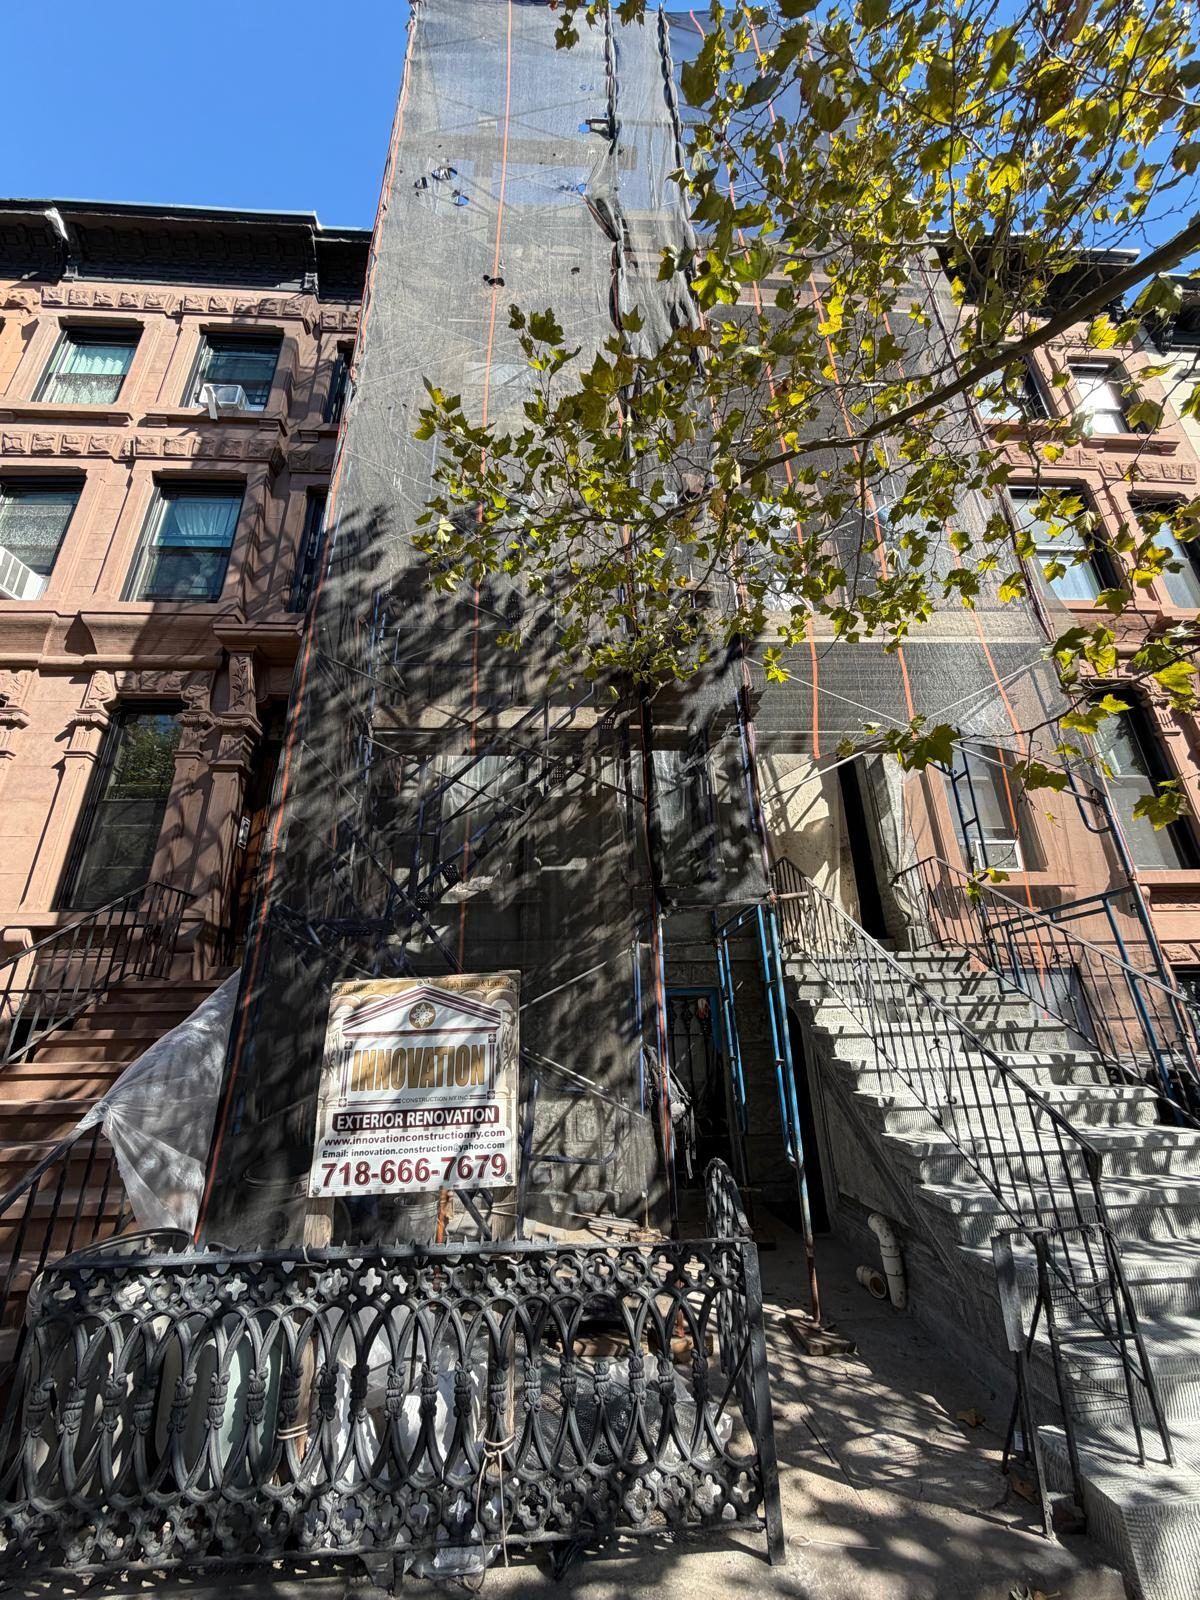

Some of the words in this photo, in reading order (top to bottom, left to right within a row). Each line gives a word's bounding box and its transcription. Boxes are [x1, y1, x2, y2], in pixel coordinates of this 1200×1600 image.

[351, 1044, 486, 1092] INNOVATION
[336, 1112, 403, 1130] EXTERIOR
[407, 1107, 496, 1126] RENOVATION
[325, 1130, 506, 1146] www.innovationconstructionny.com
[322, 1150, 349, 1158] Email:
[351, 1142, 505, 1157] innovation.construction@yahoo.com
[322, 1153, 507, 1188] 718-666-7679
